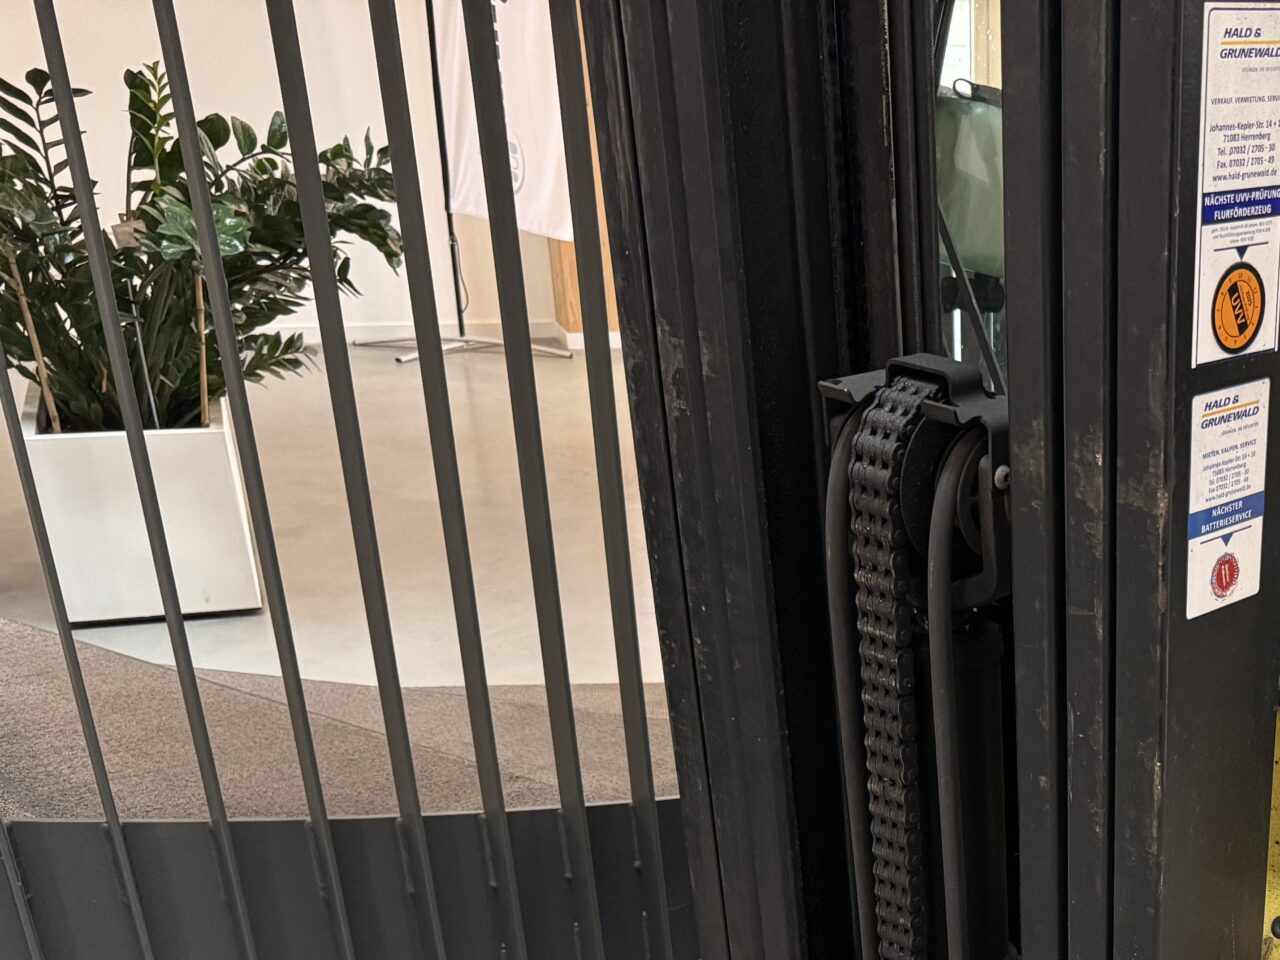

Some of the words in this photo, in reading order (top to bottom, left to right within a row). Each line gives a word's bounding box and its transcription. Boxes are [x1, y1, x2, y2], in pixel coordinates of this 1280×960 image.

[1224, 28, 1252, 38] HALD
[1254, 28, 1261, 38] &
[1266, 120, 1272, 128] 14
[1223, 134, 1239, 143] 71083
[1241, 132, 1271, 142] Herrenberg
[1218, 148, 1226, 156] Tel.
[1268, 144, 1275, 152] 30
[1228, 158, 1245, 167] 07032
[1268, 156, 1274, 164] 49
[1212, 168, 1277, 182] www.hald-grunewald.de
[1205, 193, 1234, 206] NÄCHSTE
[1214, 205, 1272, 220] FLURFÖRDERZEUG
[1231, 292, 1246, 324] UVV
[1204, 398, 1230, 412] HALD
[1232, 395, 1239, 404] &
[1201, 406, 1259, 429] GRUNEWALD
[1240, 438, 1257, 449] SERVICE
[1212, 500, 1243, 517] NÄCHSTER
[1201, 510, 1252, 533] BATTERIESERVICE
